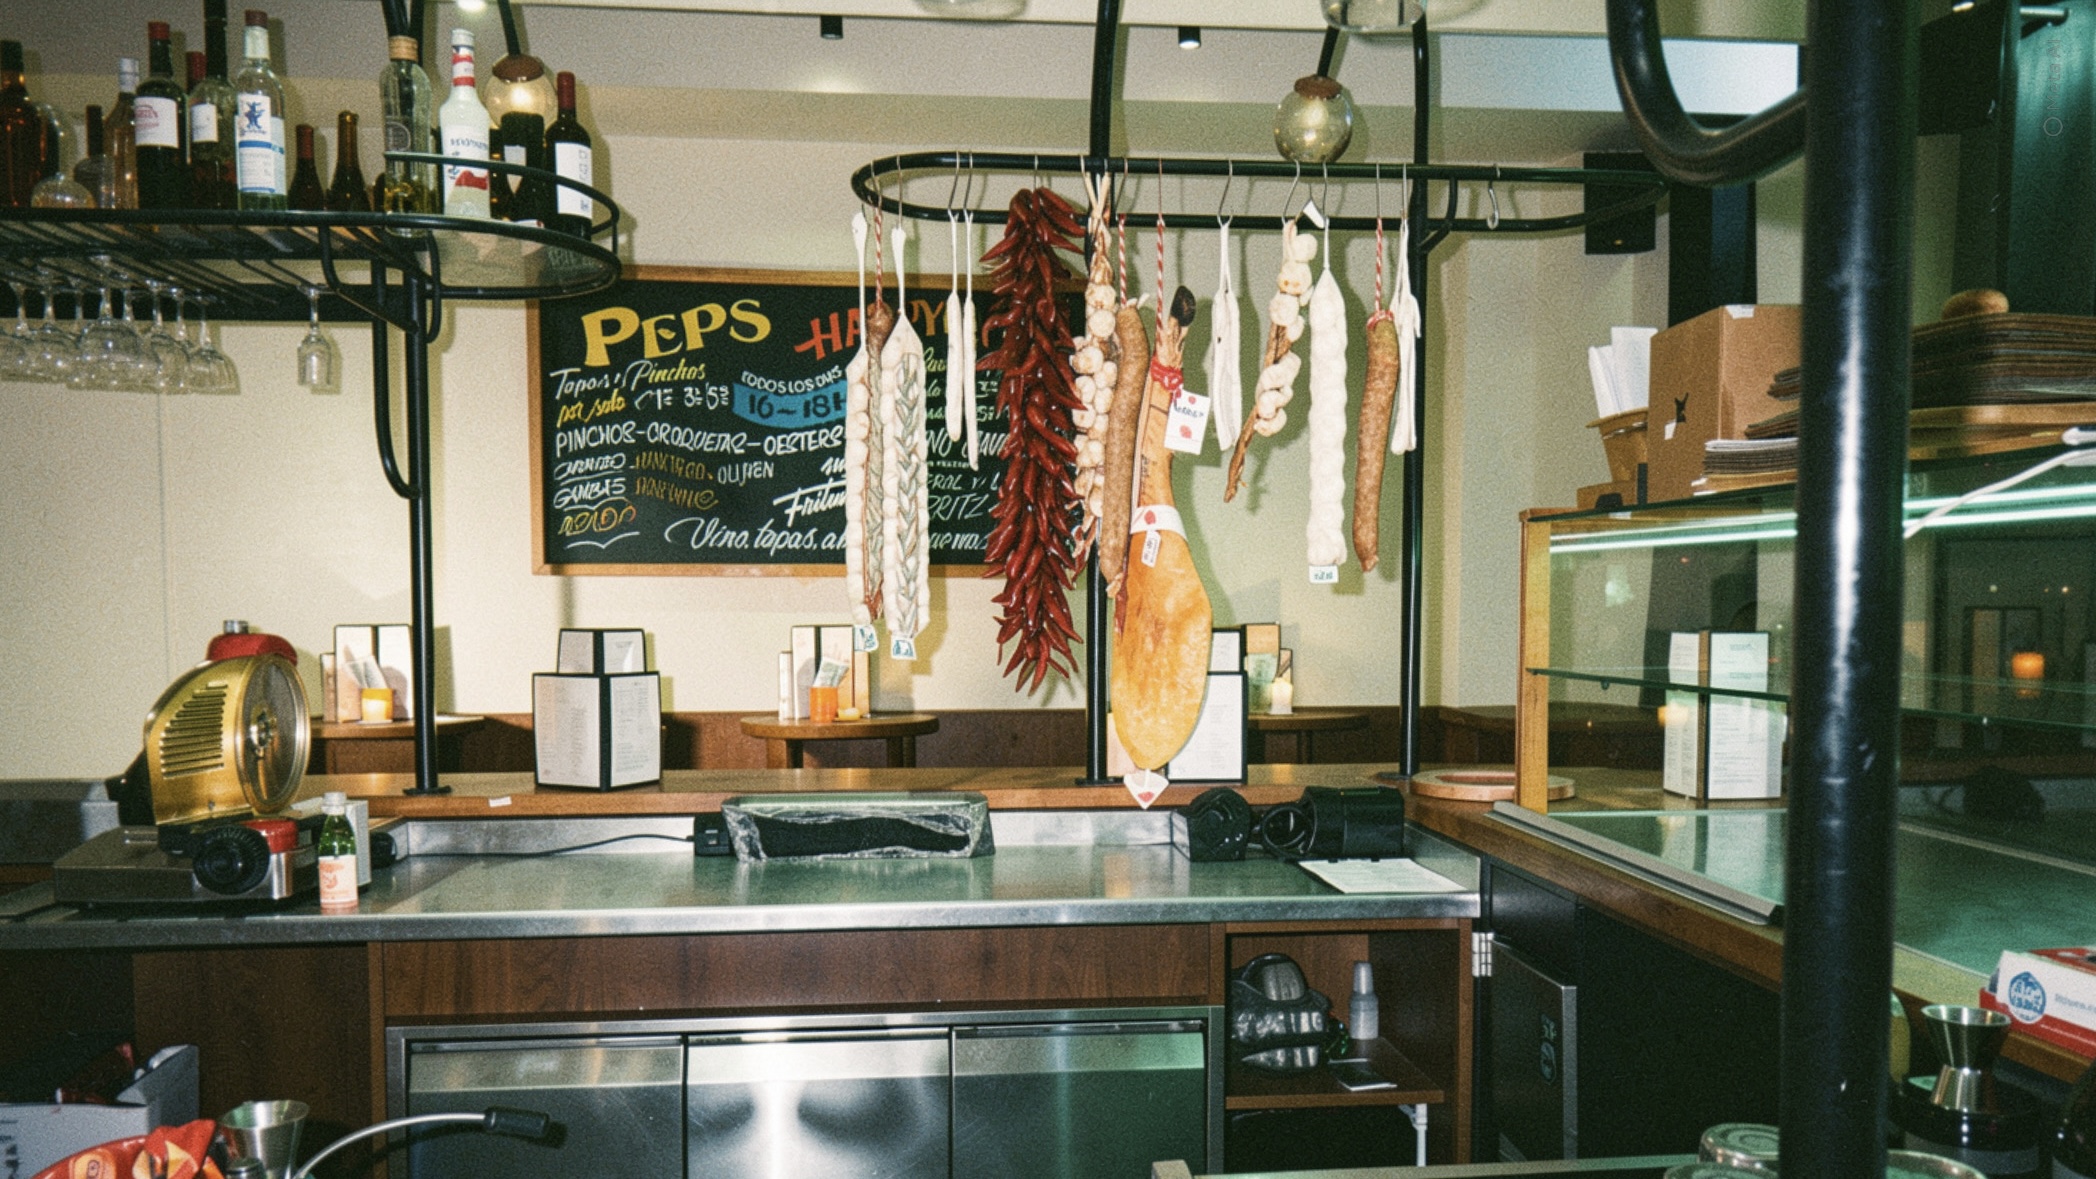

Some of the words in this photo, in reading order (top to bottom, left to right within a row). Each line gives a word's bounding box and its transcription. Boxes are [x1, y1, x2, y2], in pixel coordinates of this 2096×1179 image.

[581, 299, 772, 367] PEPS
[620, 357, 706, 391] Pinchos
[741, 370, 787, 394] TODOS
